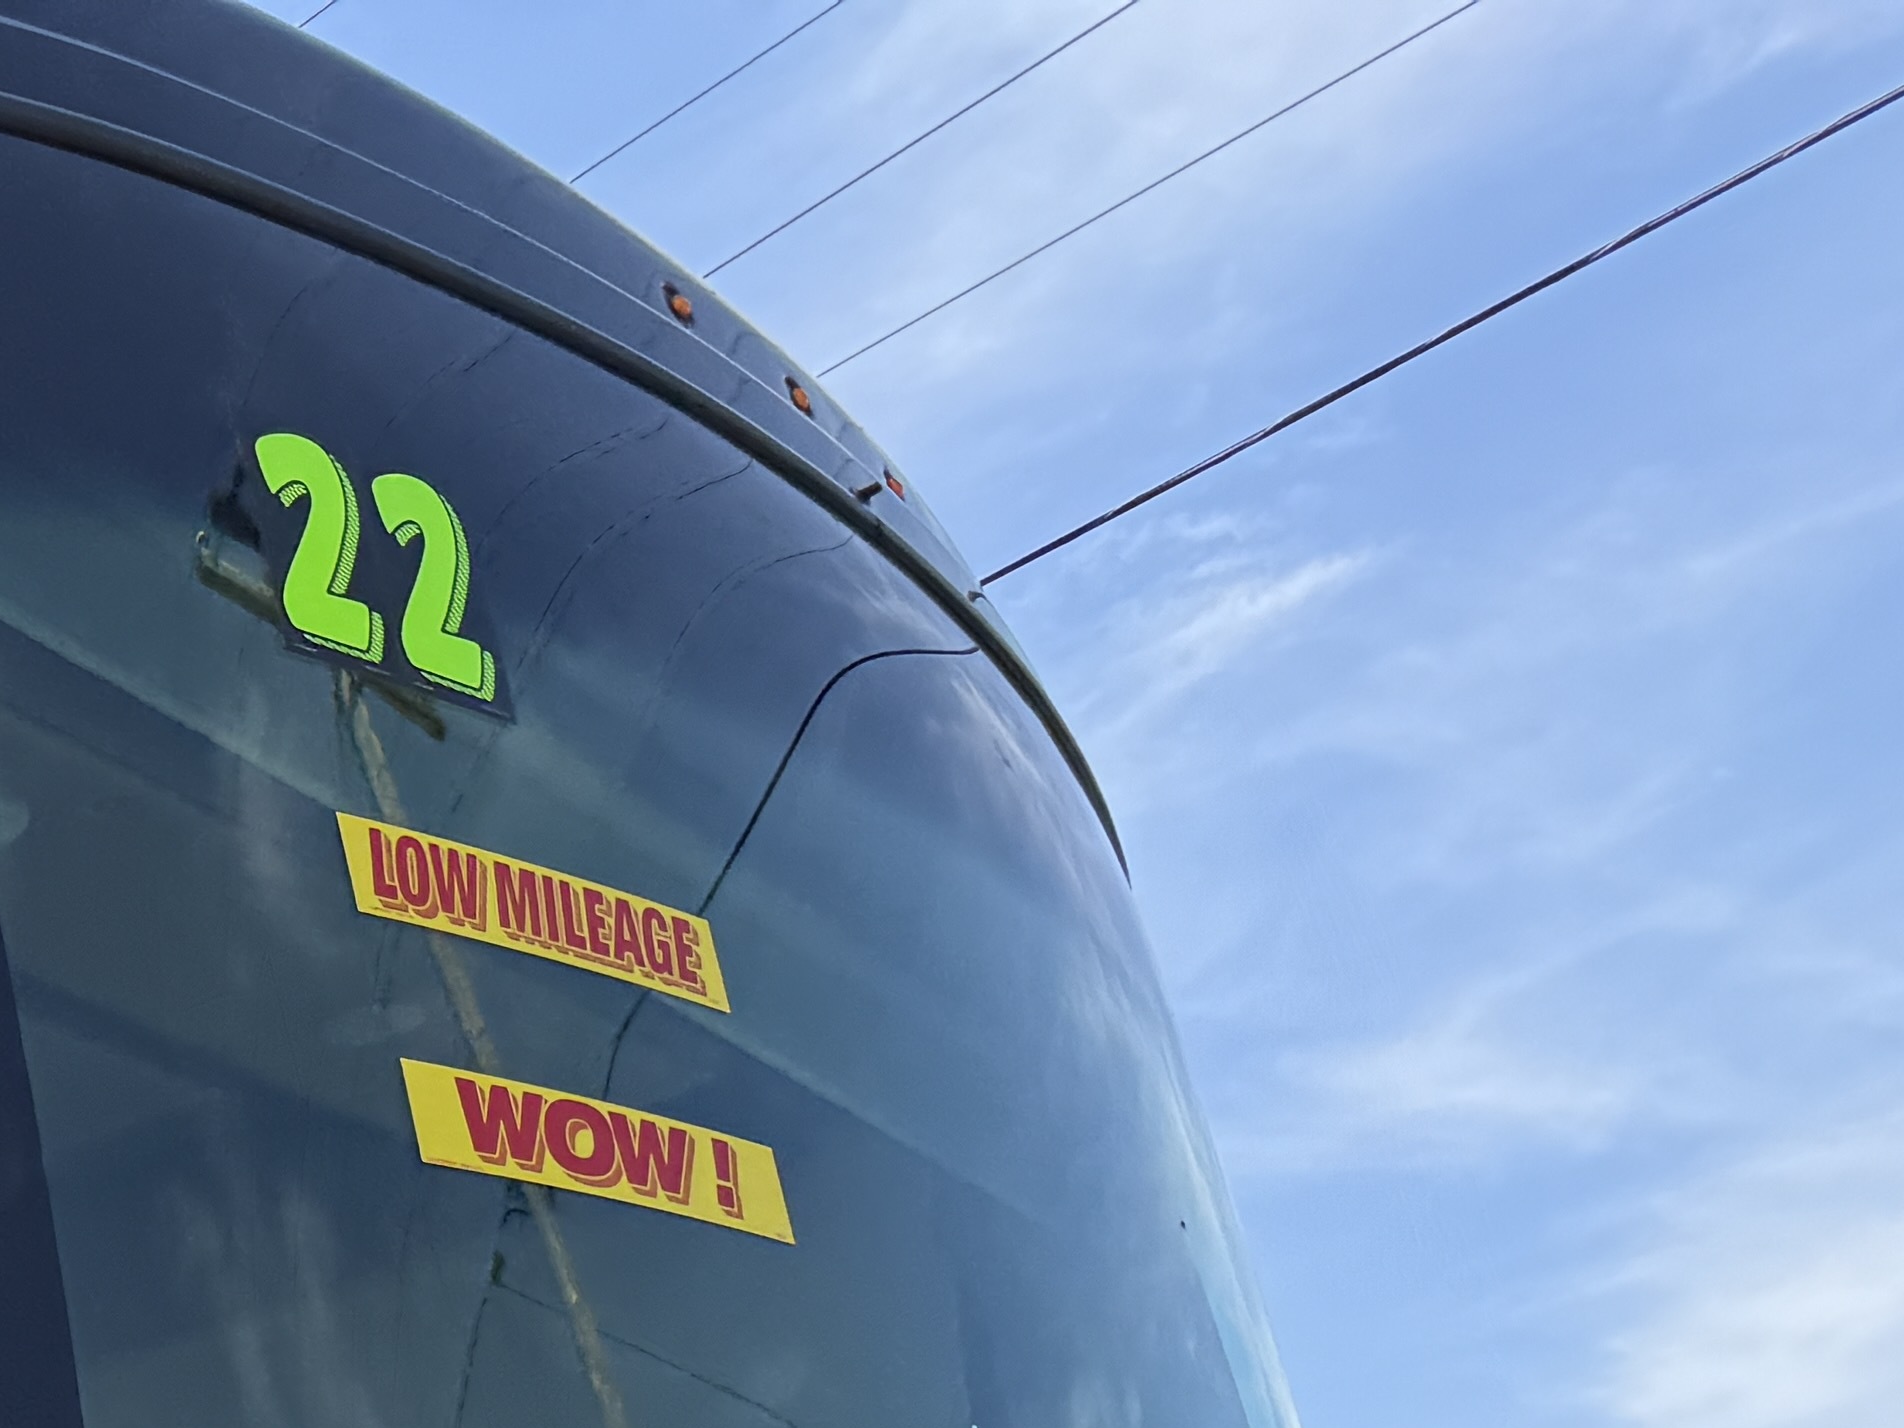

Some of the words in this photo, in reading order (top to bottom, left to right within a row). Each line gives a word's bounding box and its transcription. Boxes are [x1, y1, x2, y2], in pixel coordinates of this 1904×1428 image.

[255, 432, 495, 702] 22
[368, 828, 488, 932] LOW
[494, 861, 708, 997] MILEAGE
